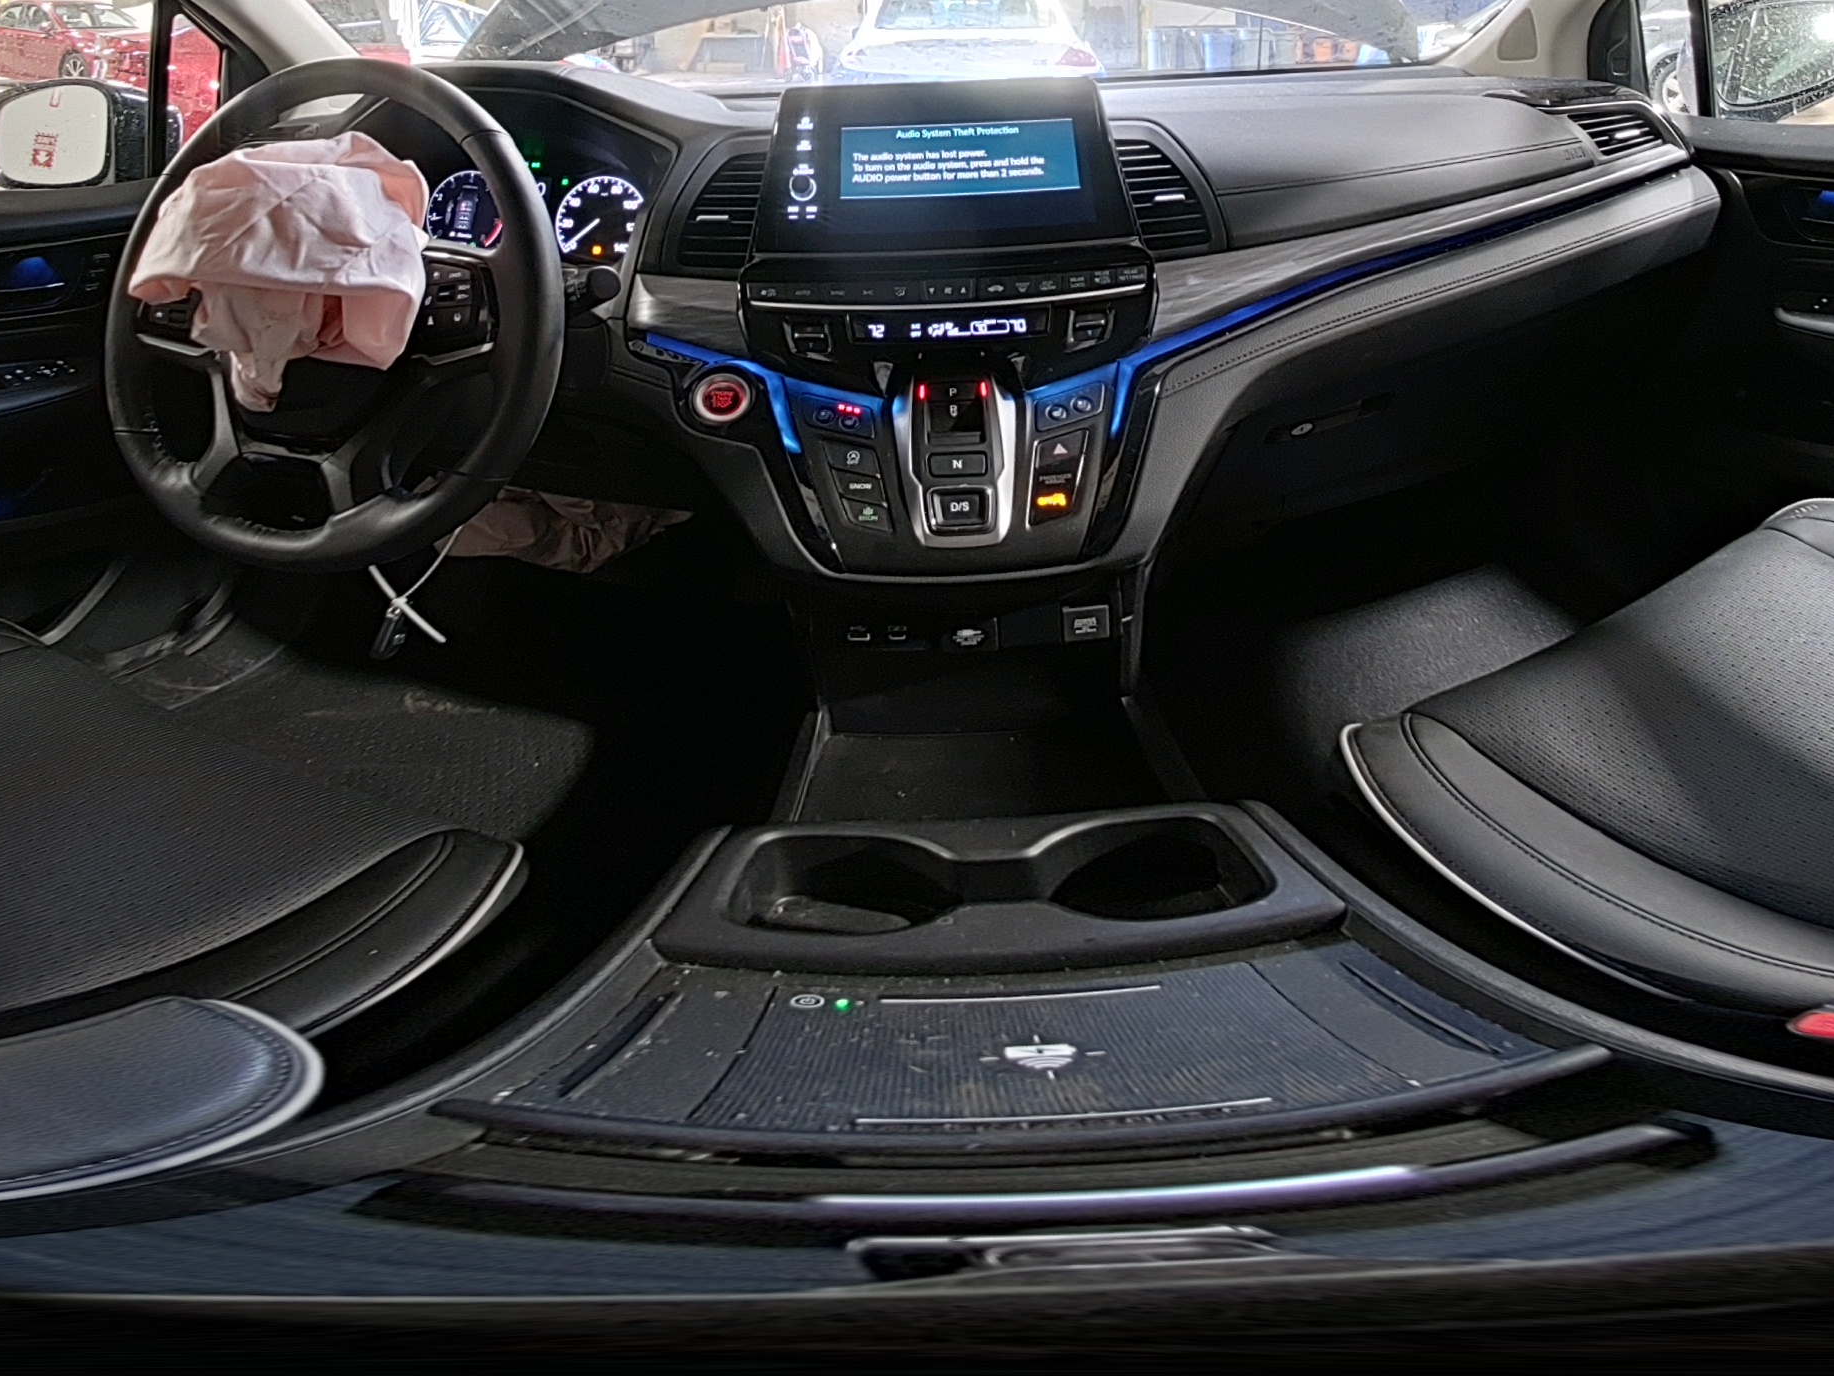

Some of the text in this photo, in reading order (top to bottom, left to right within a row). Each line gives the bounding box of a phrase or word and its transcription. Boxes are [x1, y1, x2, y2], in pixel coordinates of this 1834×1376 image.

[896, 126, 1019, 139] Audio System Theft Protection
[853, 150, 988, 162] The audio system has lost power.
[853, 163, 863, 172] To
[864, 164, 882, 172] turn
[897, 162, 911, 171] the
[912, 161, 936, 170] audio
[970, 160, 992, 169] press
[993, 158, 1009, 166] and
[1010, 156, 1029, 165] hold
[1030, 156, 1045, 165] the
[852, 167, 1044, 183] AUDIO power button for more than 2 seconds.
[587, 184, 600, 194] 60
[610, 185, 623, 194] 80
[569, 197, 581, 207] 40
[622, 200, 638, 210] 100
[562, 219, 574, 228] 20
[868, 324, 885, 338] 72
[1010, 319, 1027, 333] 70
[949, 388, 957, 396] P
[952, 460, 963, 469] N
[950, 502, 969, 512] D/S
